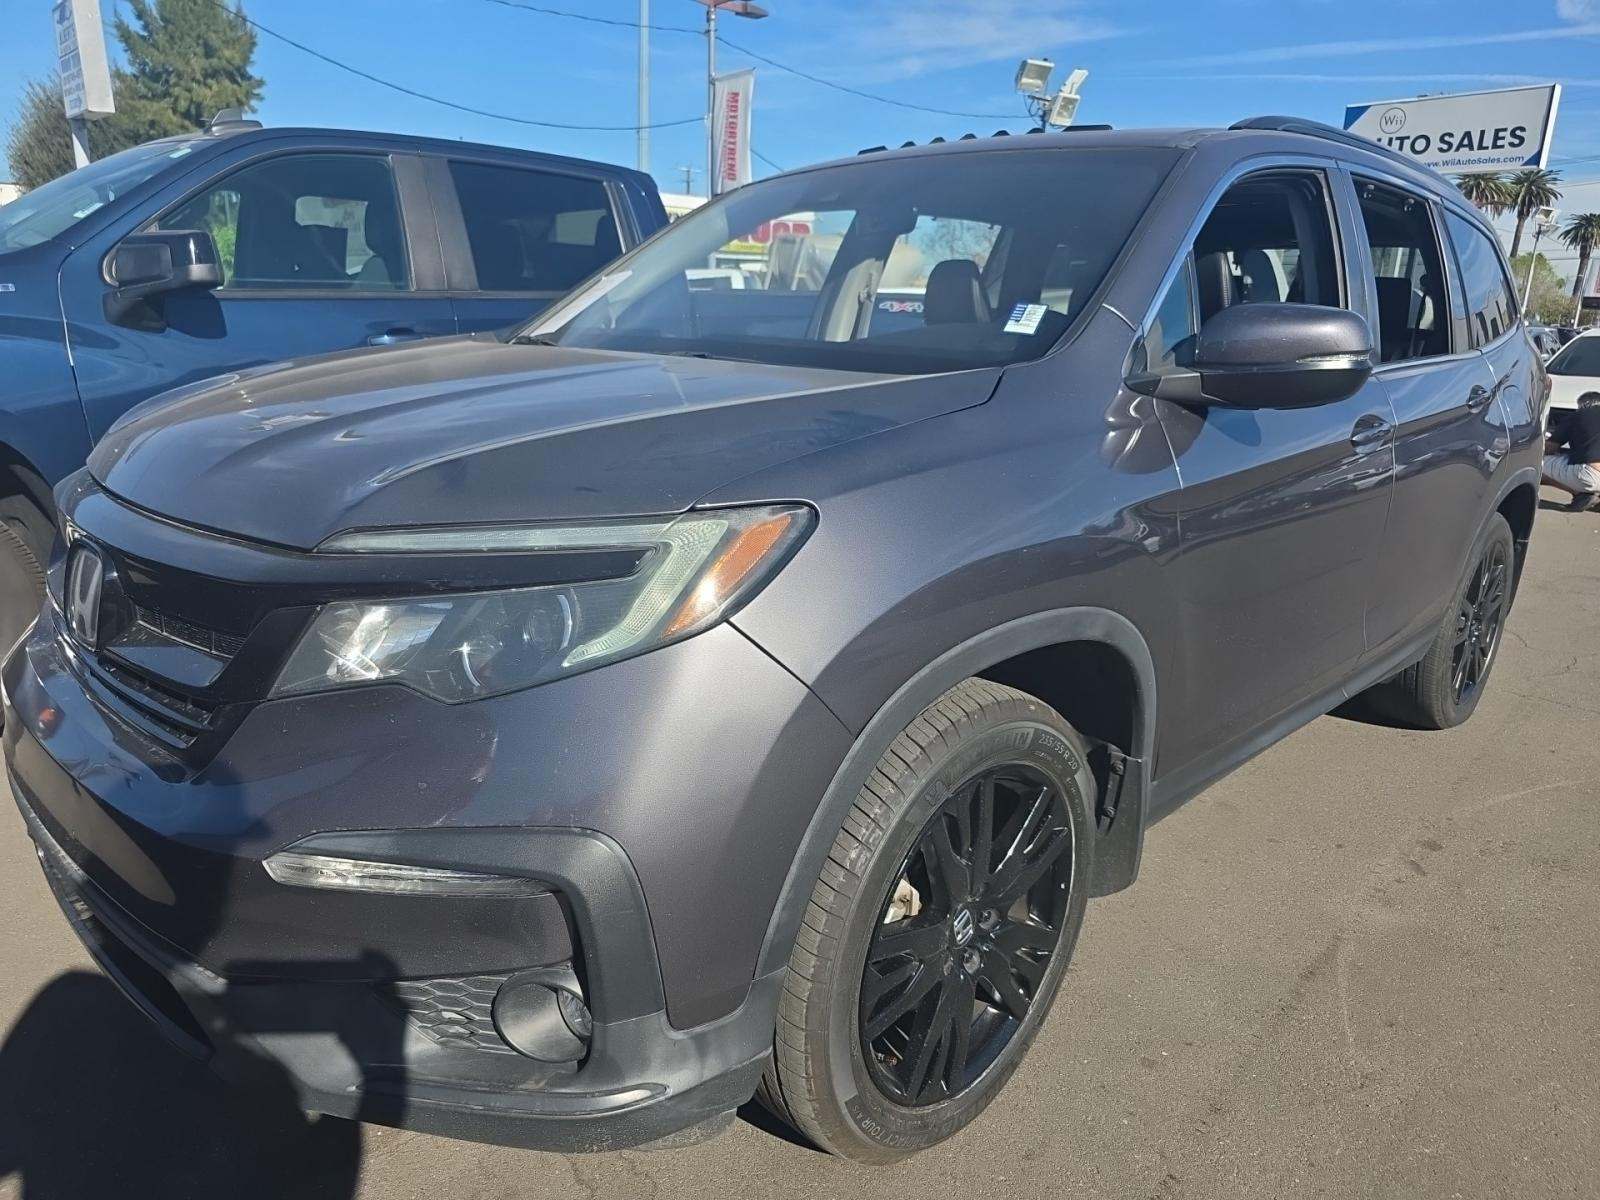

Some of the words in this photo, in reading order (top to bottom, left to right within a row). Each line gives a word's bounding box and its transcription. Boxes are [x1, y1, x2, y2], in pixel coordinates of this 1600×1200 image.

[725, 91, 741, 181] MOTORTREND
[1377, 134, 1430, 155] TO
[1438, 126, 1526, 153] SALES
[1424, 155, 1525, 169] ww.WiiAutoSales.com
[1038, 733, 1065, 754] 235/55
[862, 1118, 885, 1139] TOUR
